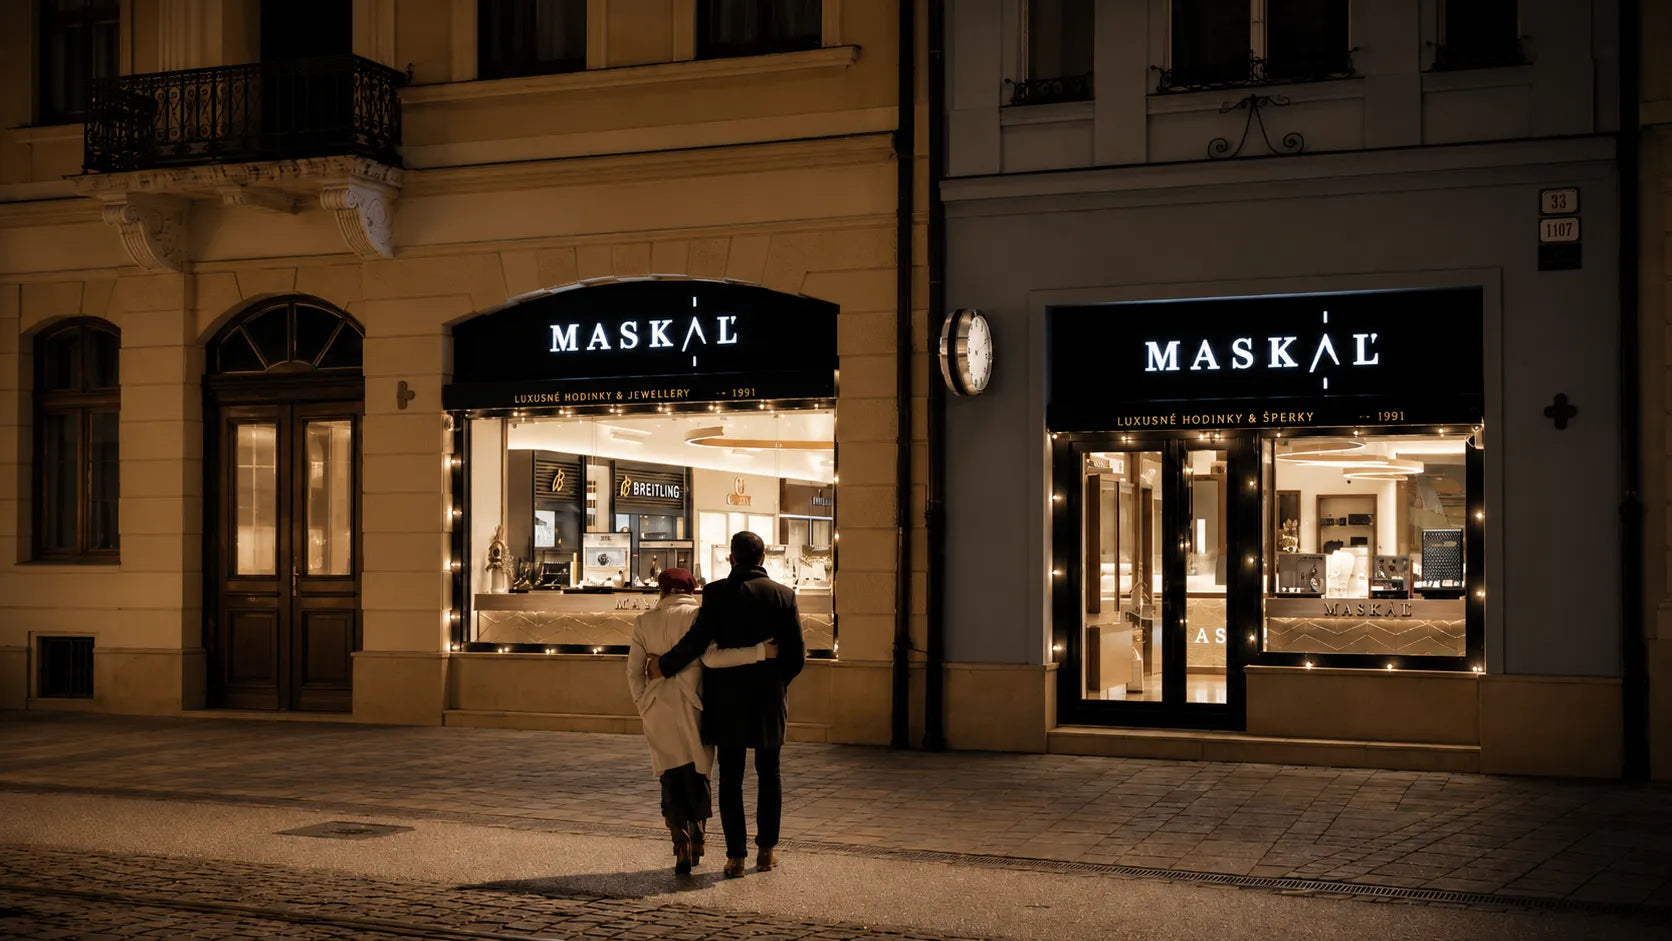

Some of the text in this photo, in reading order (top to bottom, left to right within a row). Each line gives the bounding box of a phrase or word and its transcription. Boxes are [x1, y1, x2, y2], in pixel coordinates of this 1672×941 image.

[1551, 194, 1567, 209] 33
[1546, 222, 1573, 238] 1107
[514, 387, 756, 403] LUXUSNÉ HODINKY & JEWELLERY 1991
[1117, 411, 1404, 426] LUXUSNÉ HODINKY & ŠPERKY 1991
[633, 481, 680, 499] BREITLING
